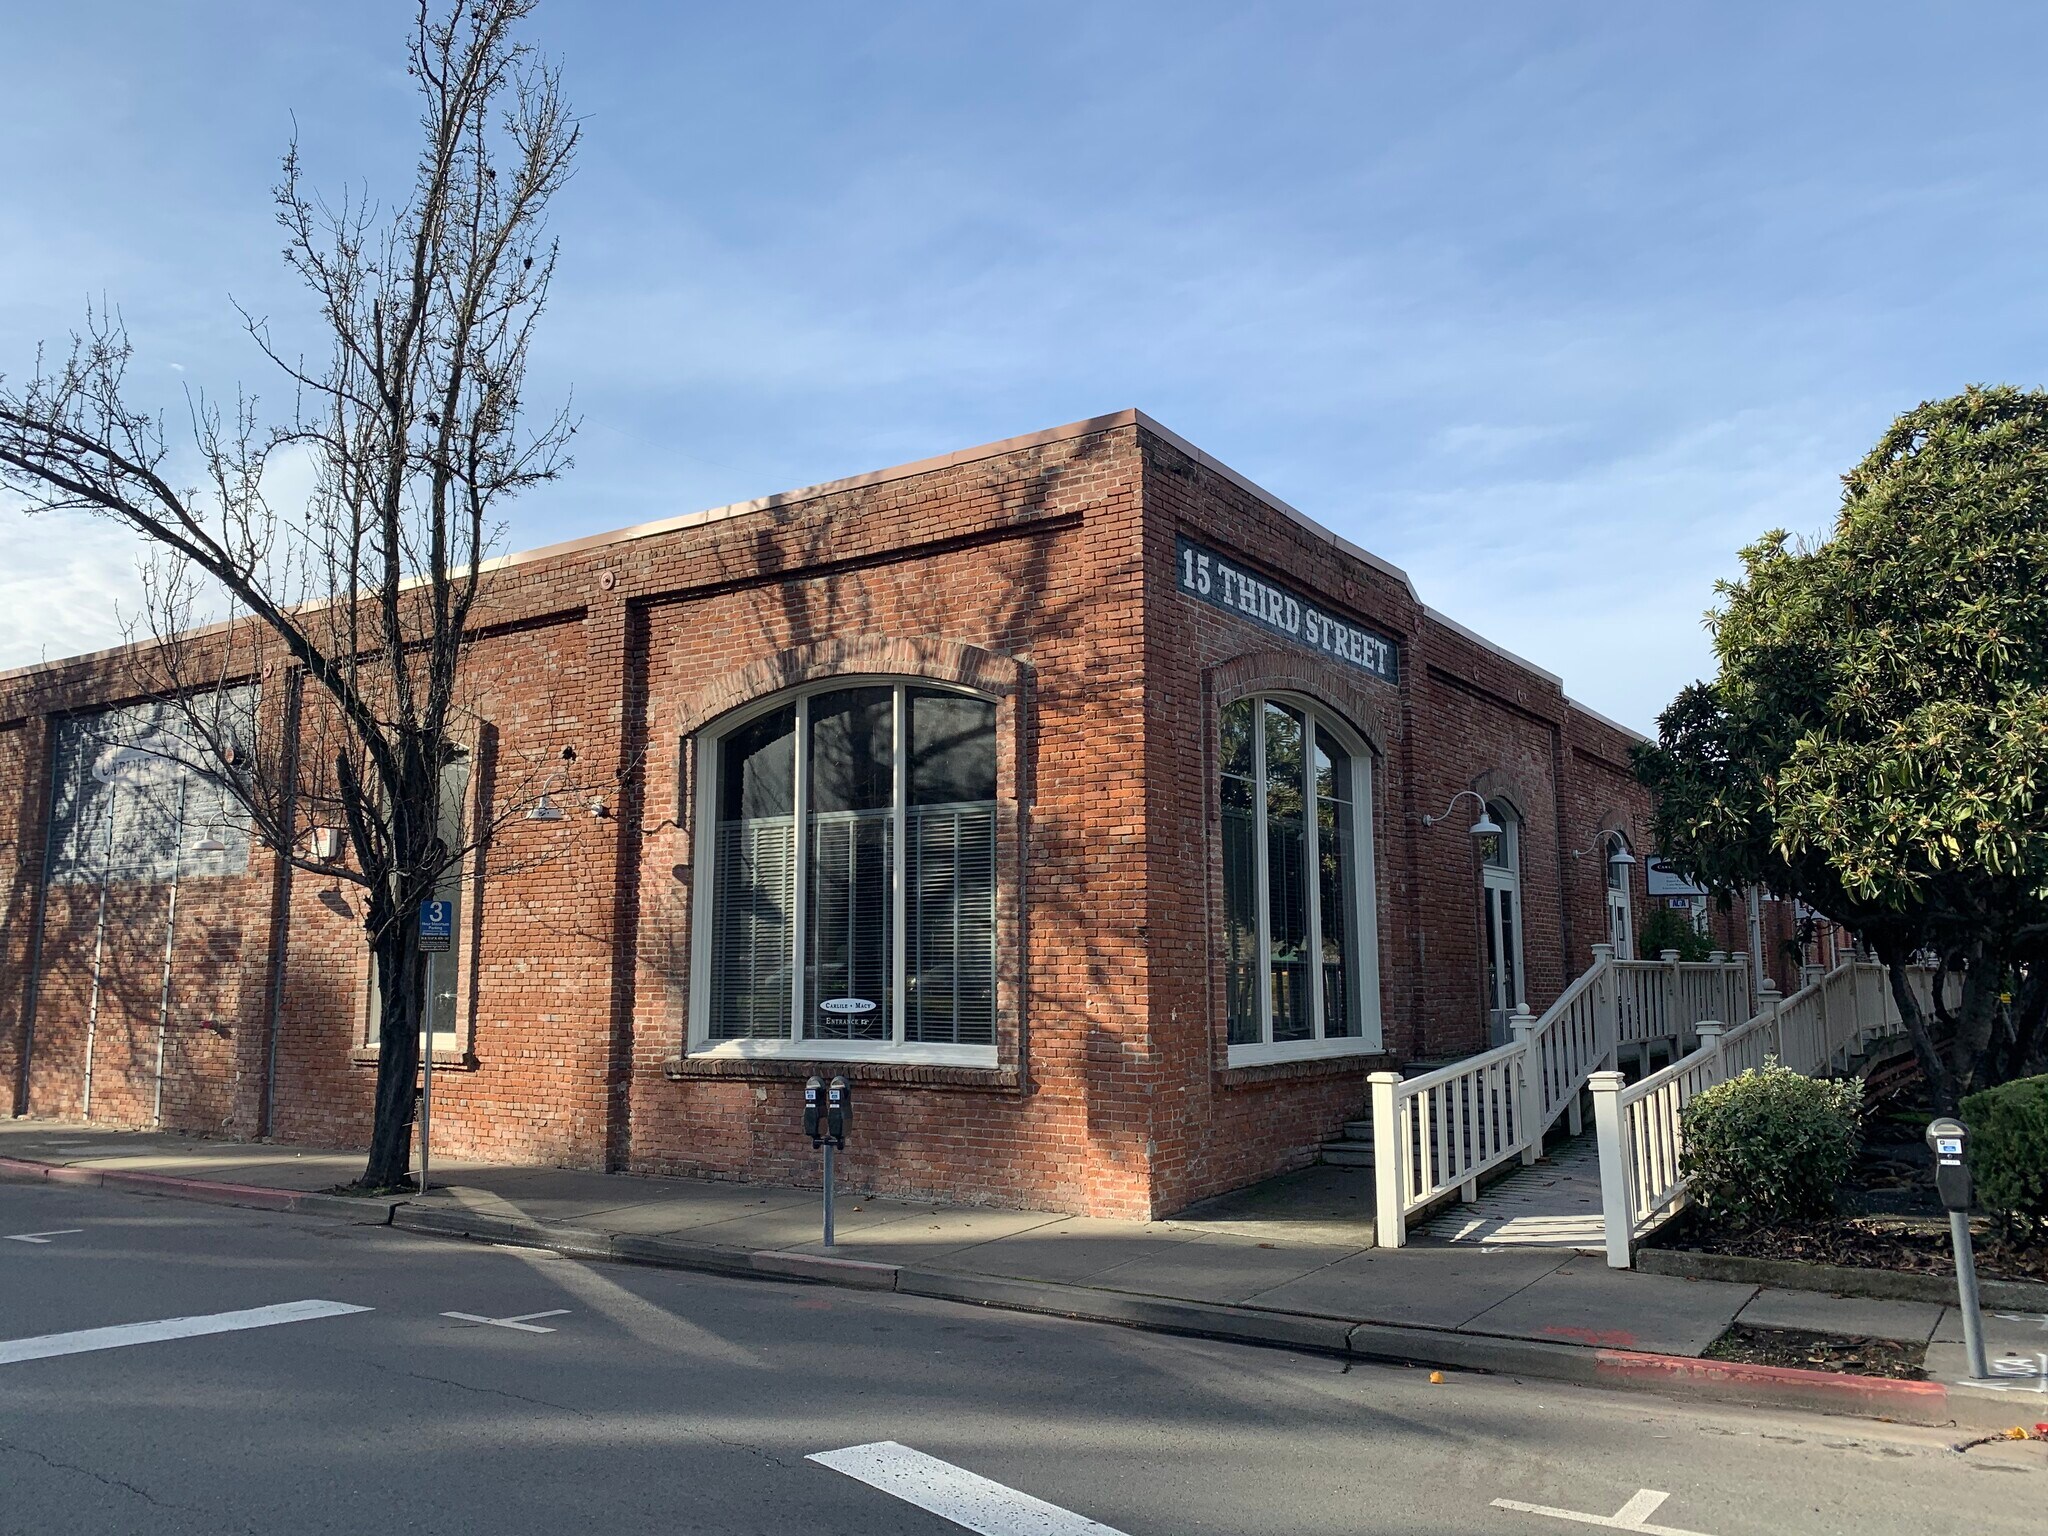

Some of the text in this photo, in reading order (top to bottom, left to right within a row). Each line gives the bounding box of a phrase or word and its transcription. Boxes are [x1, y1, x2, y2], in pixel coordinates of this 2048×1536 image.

[1183, 548, 1388, 675] 15 THIRD STREET
[429, 901, 443, 922] 3
[825, 1017, 859, 1025] ENTRANCE
